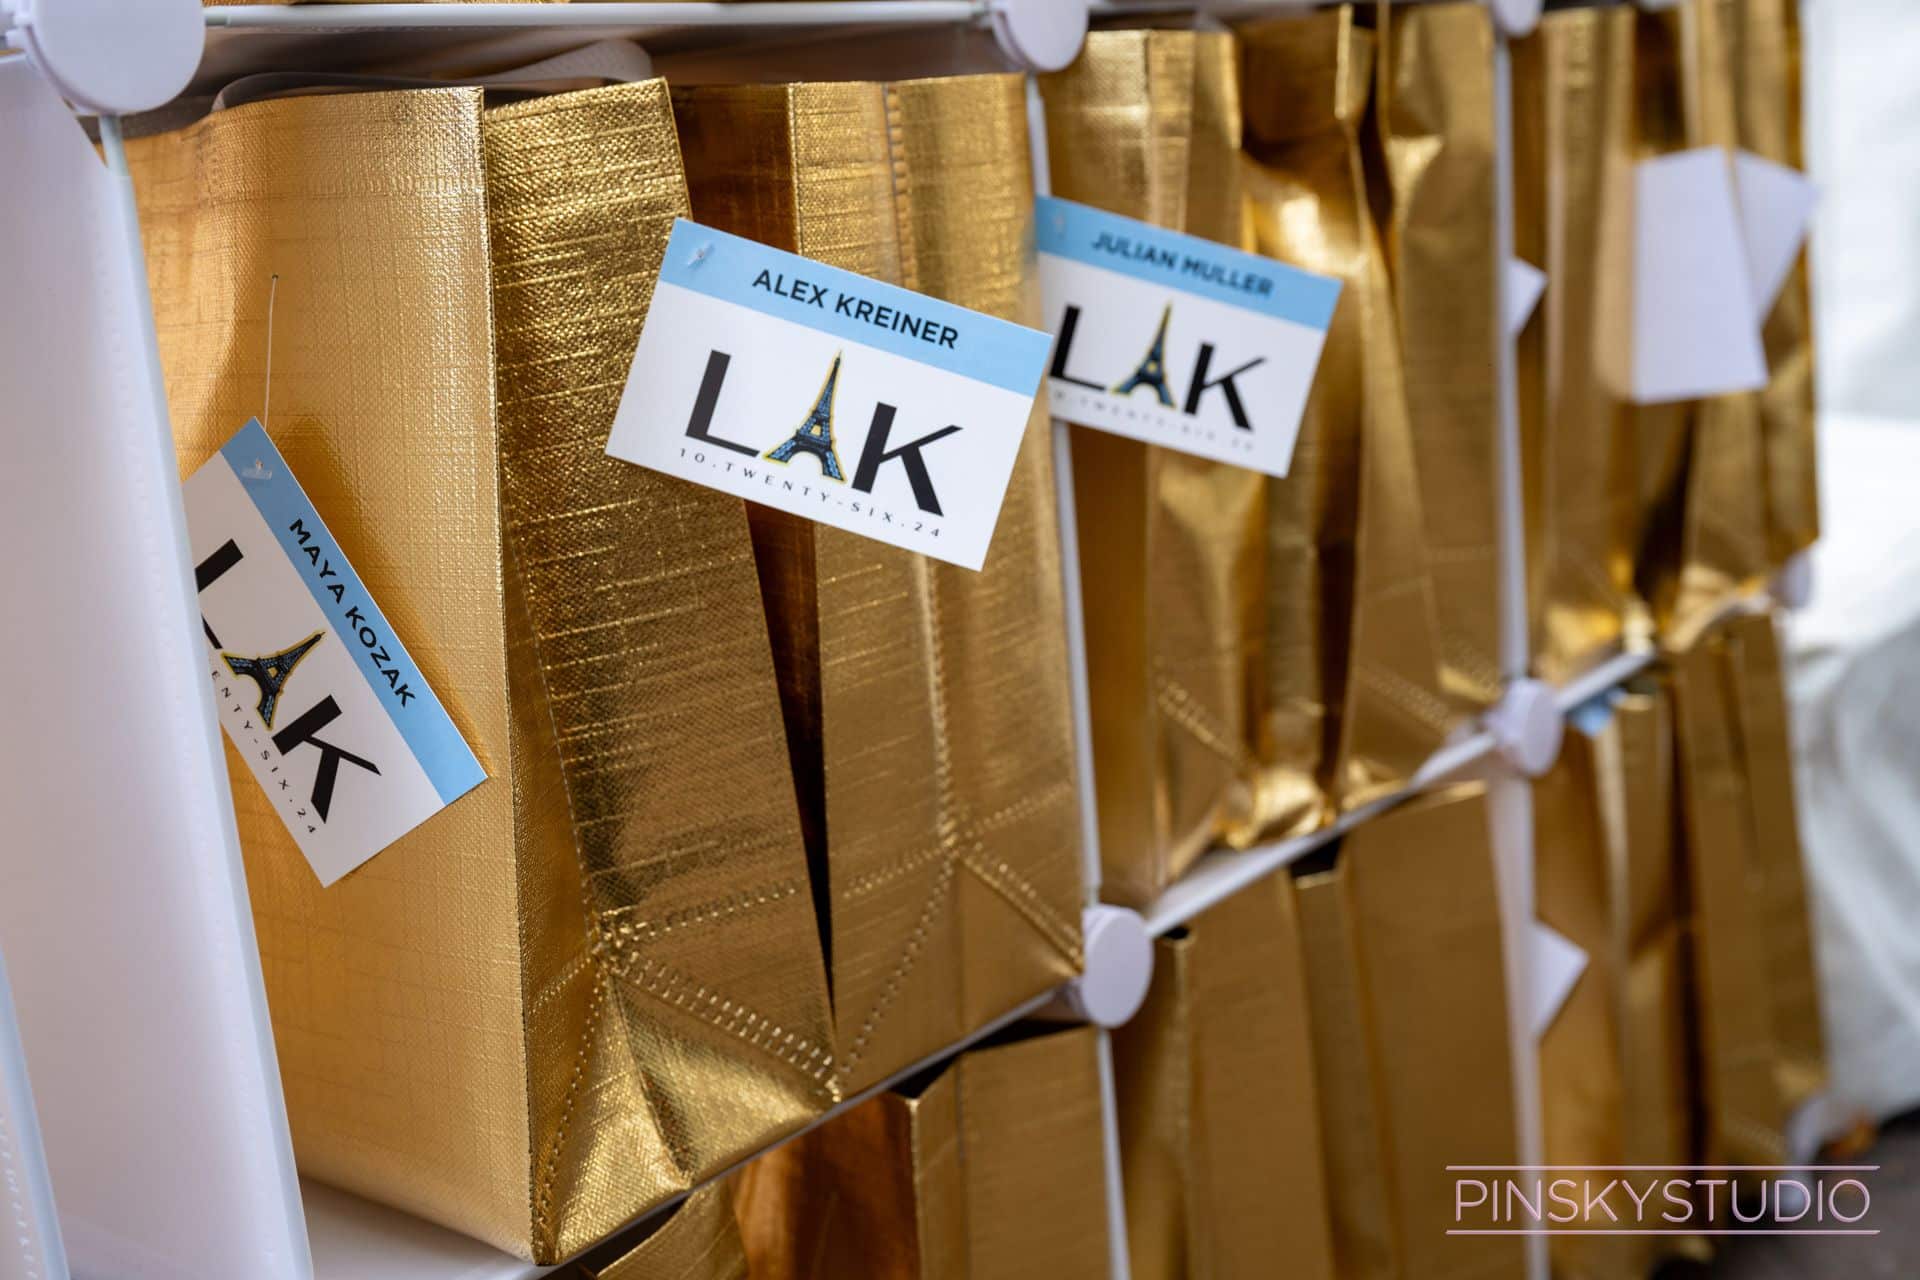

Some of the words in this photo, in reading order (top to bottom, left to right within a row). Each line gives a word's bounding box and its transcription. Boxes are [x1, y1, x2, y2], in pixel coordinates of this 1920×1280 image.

[752, 269, 825, 308] ALEX
[835, 293, 960, 349] KREINER
[1092, 232, 1175, 270] JULIAN
[1181, 254, 1275, 297] MULLER
[680, 448, 941, 538] 10.TWENTY-SIX.24
[685, 349, 963, 517] LAK
[289, 518, 345, 603] MAYA
[345, 606, 416, 708] KOZAK
[211, 670, 317, 833] ENTY-SIX.24
